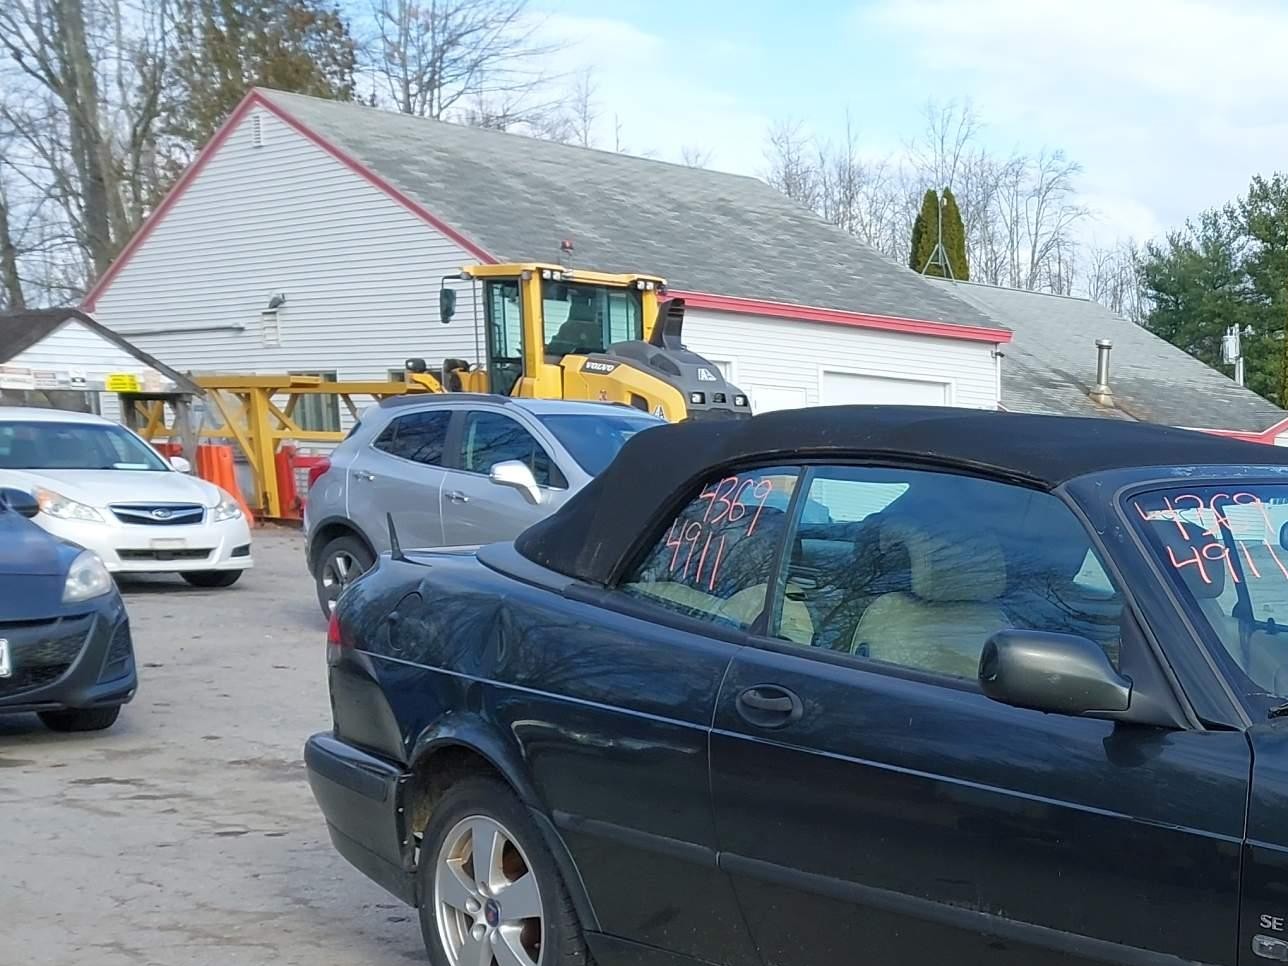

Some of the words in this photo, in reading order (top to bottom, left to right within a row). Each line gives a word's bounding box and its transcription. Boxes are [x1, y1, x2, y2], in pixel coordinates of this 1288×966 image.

[585, 361, 615, 372] VOLVO
[699, 476, 773, 537] 4369
[666, 517, 726, 591] 4911
[1260, 914, 1285, 931] SE
